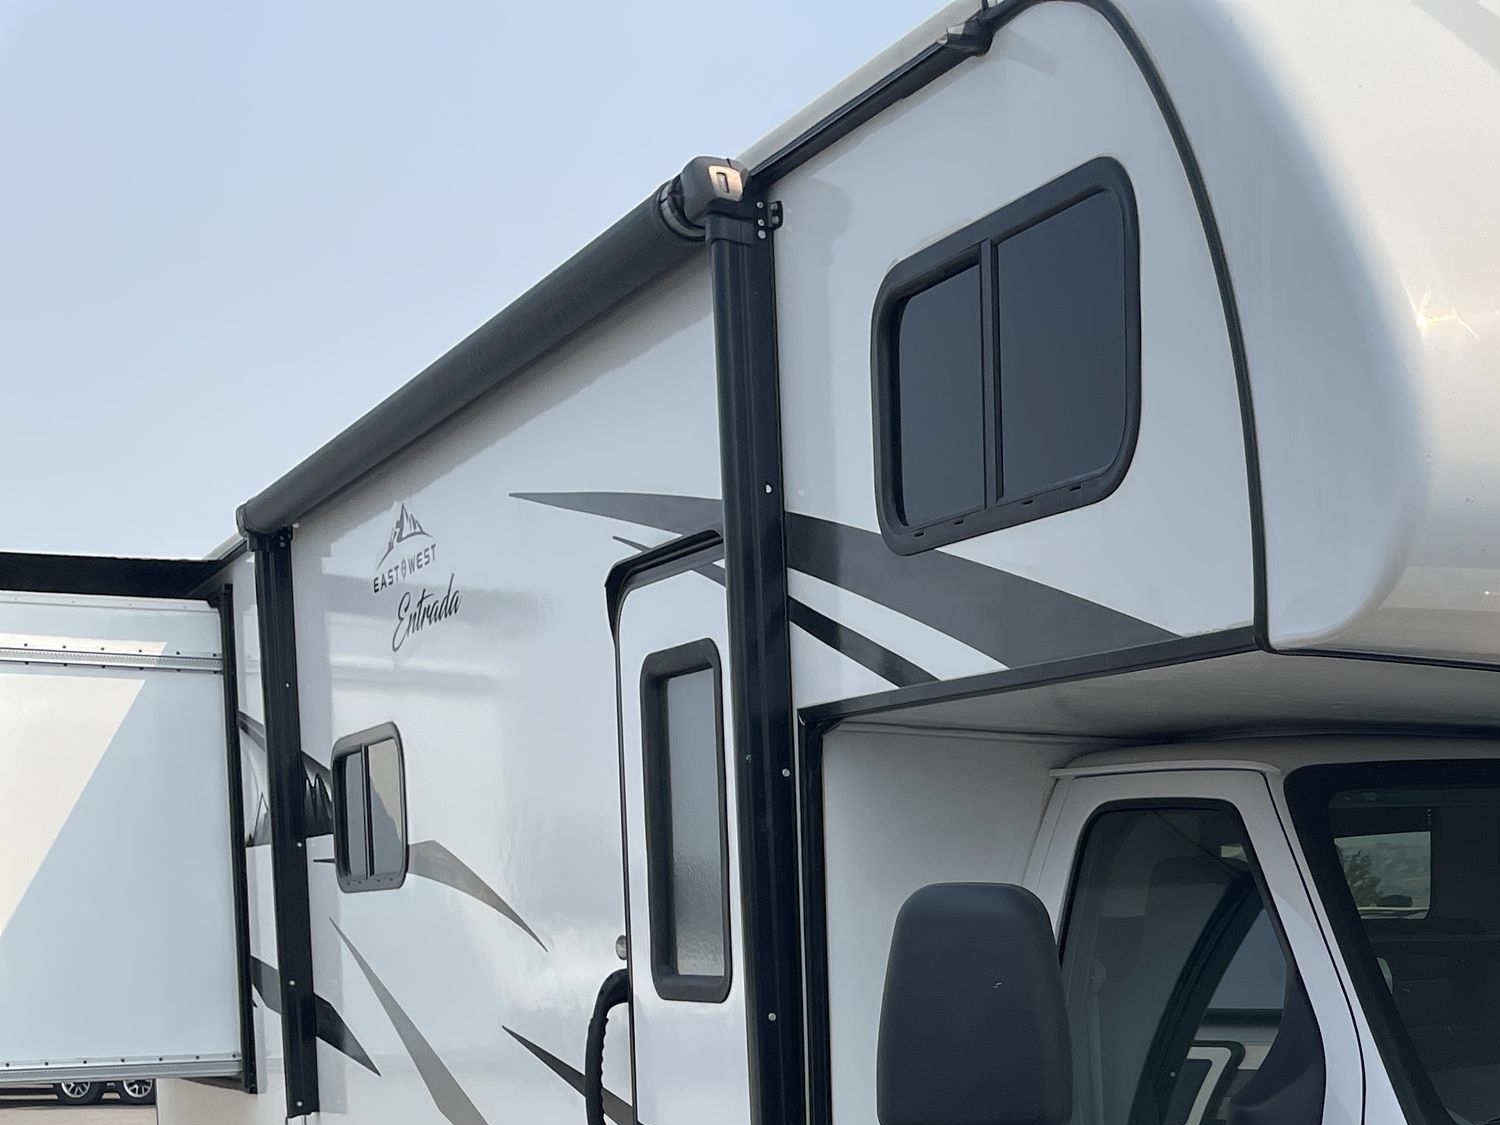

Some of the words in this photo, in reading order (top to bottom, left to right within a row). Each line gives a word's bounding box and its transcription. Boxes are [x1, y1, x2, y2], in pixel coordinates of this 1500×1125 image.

[373, 565, 400, 593] EAST
[408, 544, 437, 575] WEST
[392, 573, 463, 652] Entrada
